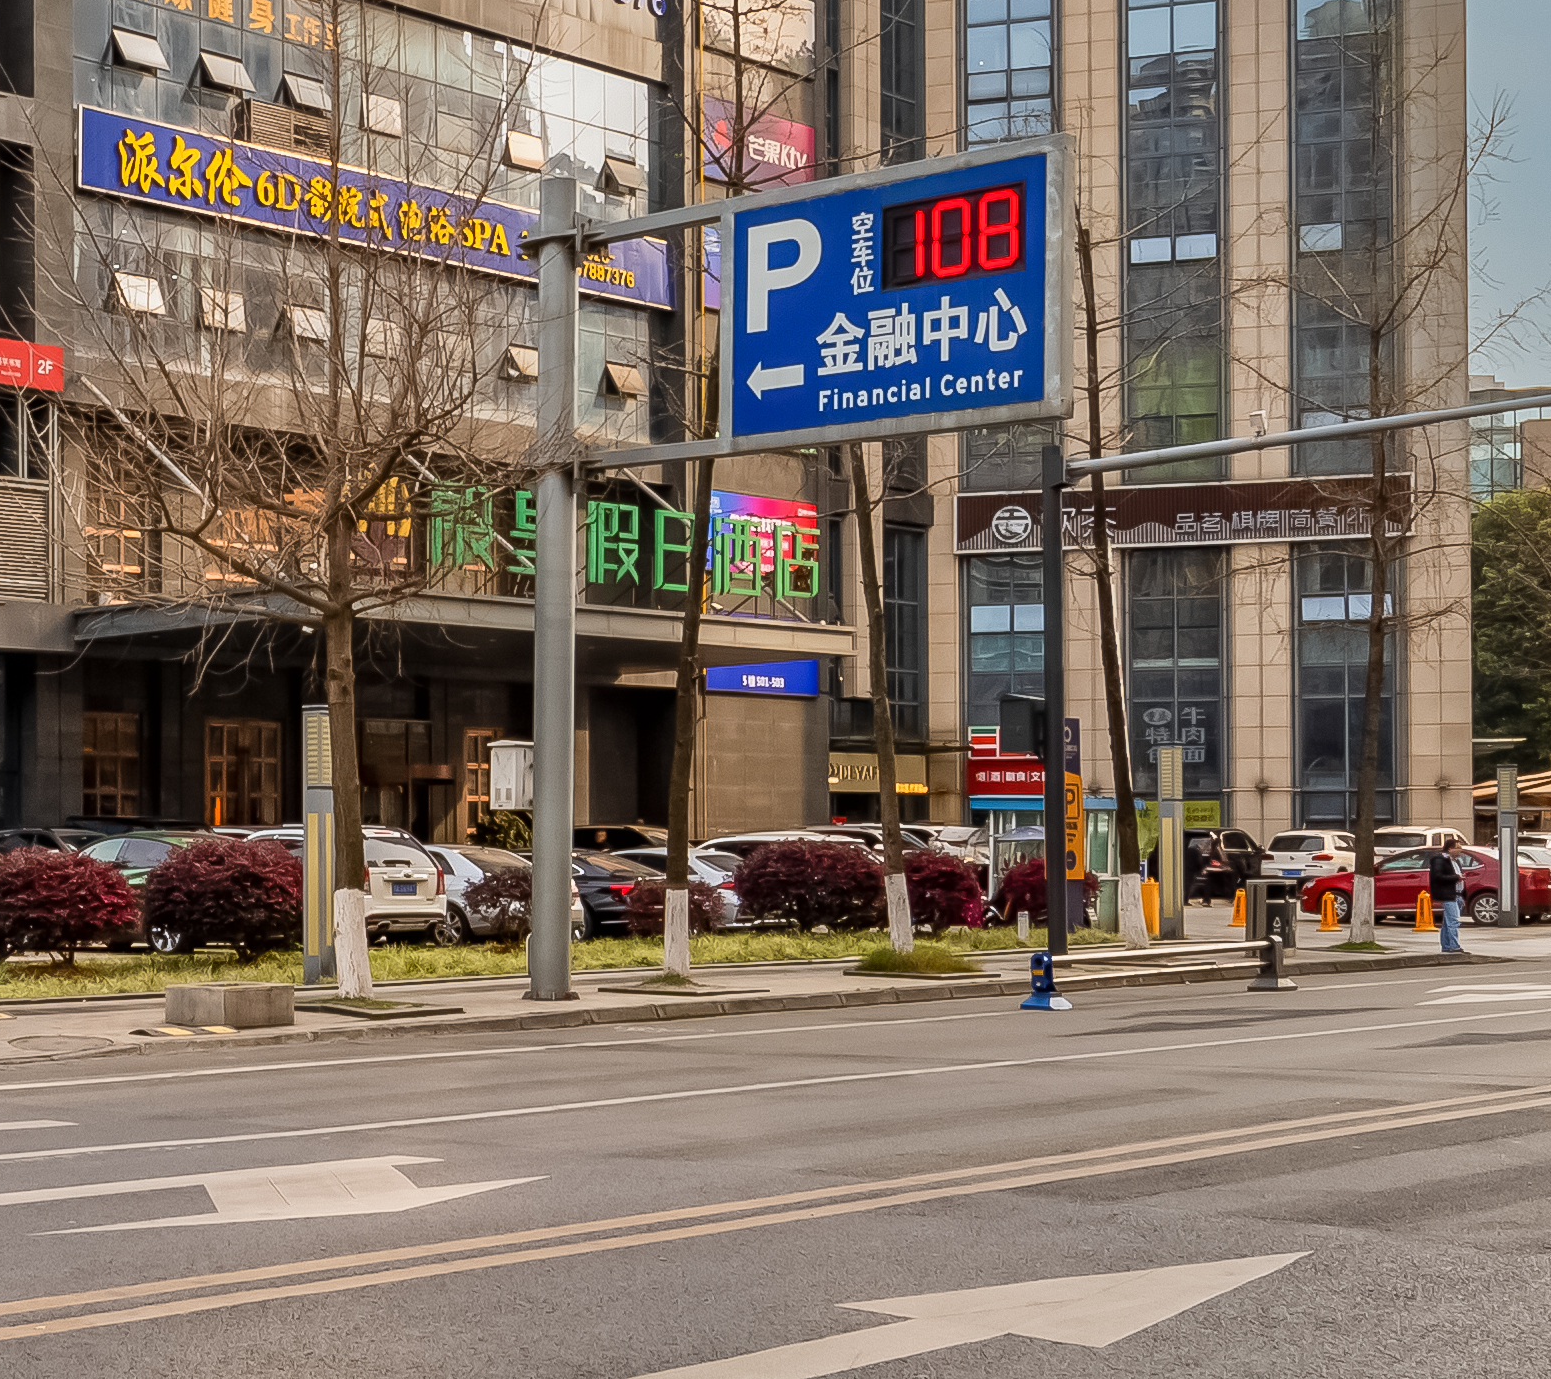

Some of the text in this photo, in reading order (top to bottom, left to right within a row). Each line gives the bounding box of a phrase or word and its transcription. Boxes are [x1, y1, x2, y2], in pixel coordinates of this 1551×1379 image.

[747, 218, 822, 333] P
[851, 212, 874, 295] 空车位
[914, 188, 1019, 278] 108
[37, 359, 53, 374] 2F
[816, 287, 1027, 376] 金融中心
[818, 369, 1024, 412] Financial Center
